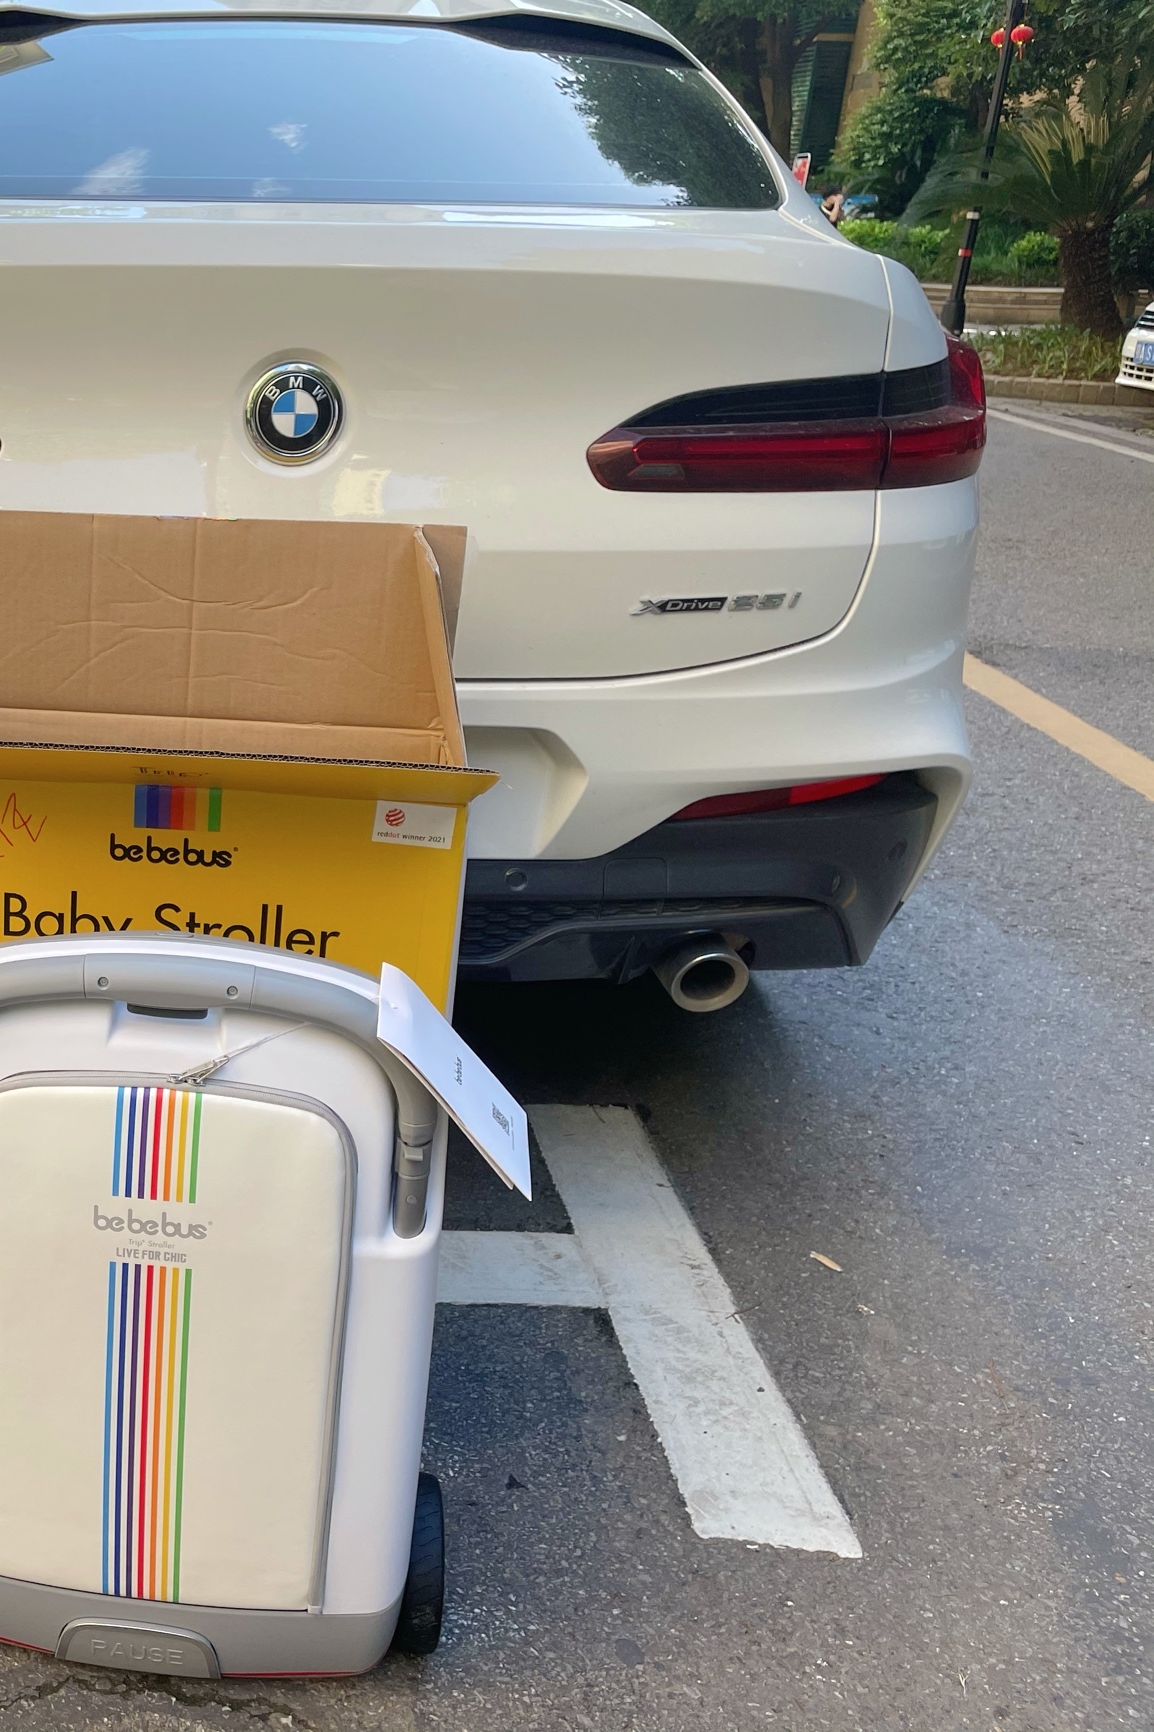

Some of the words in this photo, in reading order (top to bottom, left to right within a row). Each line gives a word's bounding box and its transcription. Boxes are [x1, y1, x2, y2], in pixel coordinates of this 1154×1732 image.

[265, 376, 327, 401] BMW
[110, 833, 233, 868] bebebus
[428, 835, 446, 843] 2021
[93, 1204, 208, 1240] bebebus
[116, 1247, 139, 1259] LIVE
[142, 1249, 161, 1261] FOR
[164, 1251, 187, 1263] CHIC
[148, 1240, 175, 1249] Stroller
[90, 1639, 184, 1665] PAUSE
